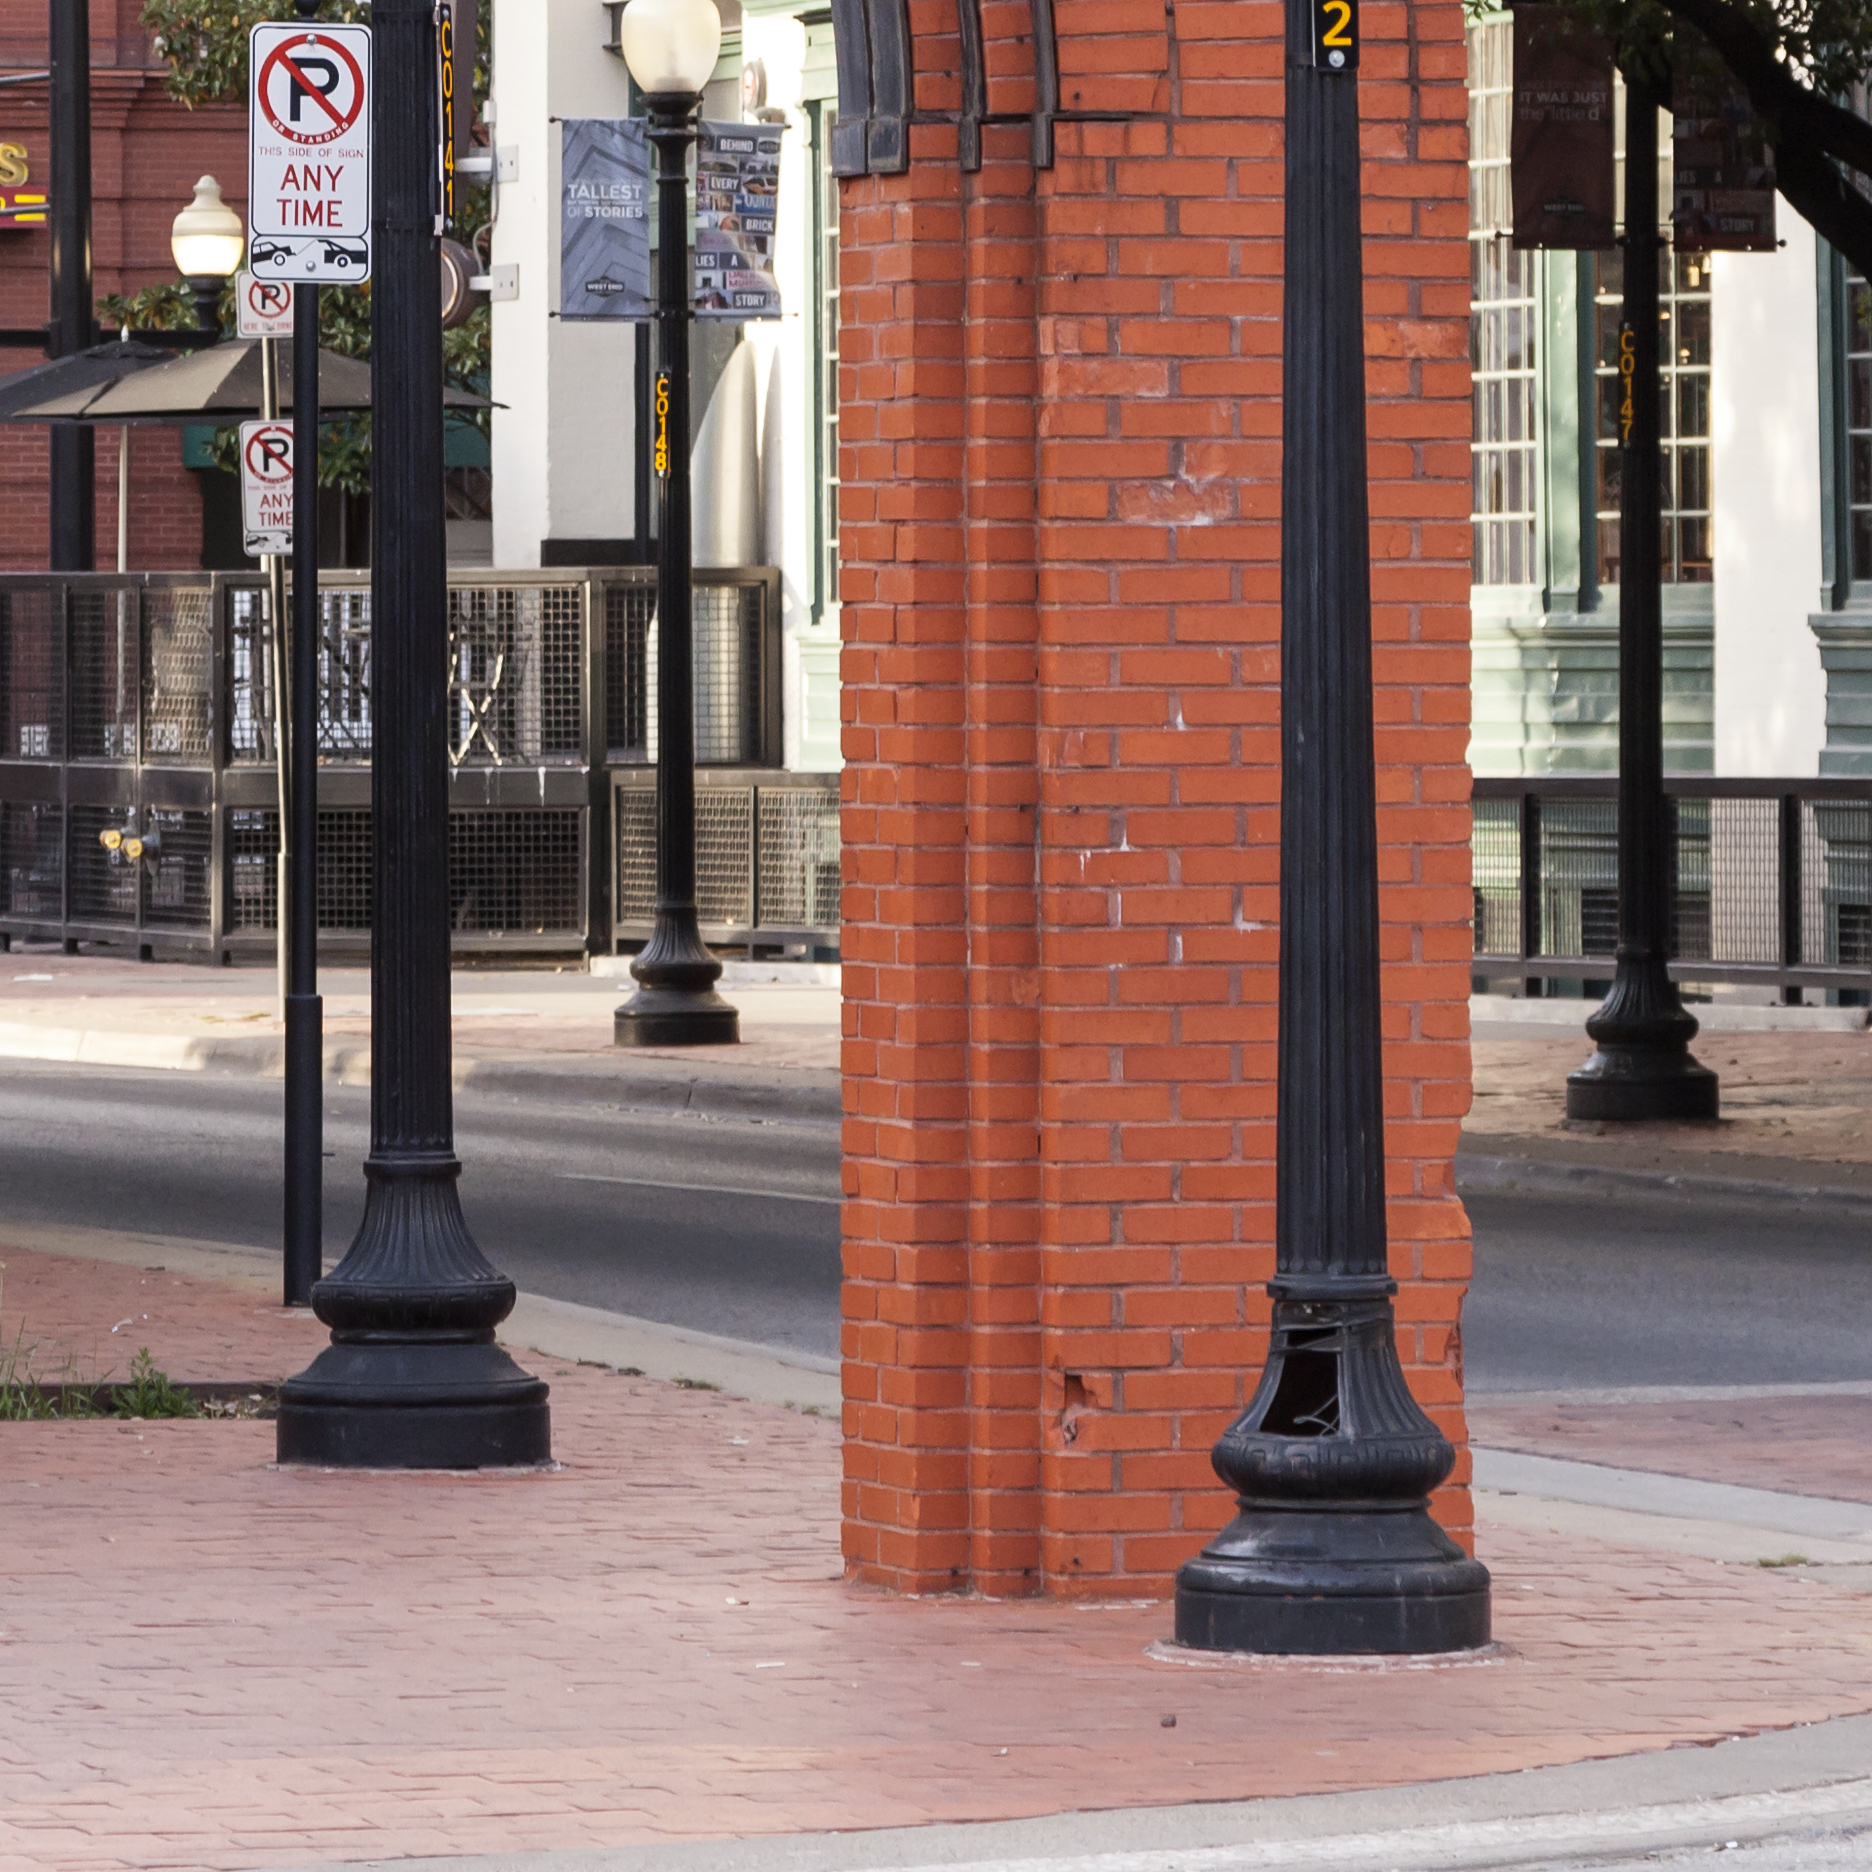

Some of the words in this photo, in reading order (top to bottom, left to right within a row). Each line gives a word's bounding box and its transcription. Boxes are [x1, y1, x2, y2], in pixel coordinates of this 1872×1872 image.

[292, 121, 350, 144] STANDING
[258, 146, 282, 156] THIS
[288, 146, 313, 157] SIDE
[318, 147, 333, 157] OF
[338, 148, 364, 158] SIGN
[720, 138, 754, 153] BEHIND
[280, 163, 345, 192] ANY
[710, 176, 740, 191] EVERY
[567, 183, 643, 200] TALLEST
[276, 199, 343, 228] TIME
[584, 206, 643, 219] STORIES
[745, 215, 774, 232] BRICK
[695, 254, 716, 268] LIES
[730, 255, 738, 267] A
[735, 293, 765, 307] STORY
[260, 493, 293, 509] ANY
[259, 511, 293, 527] TIME
